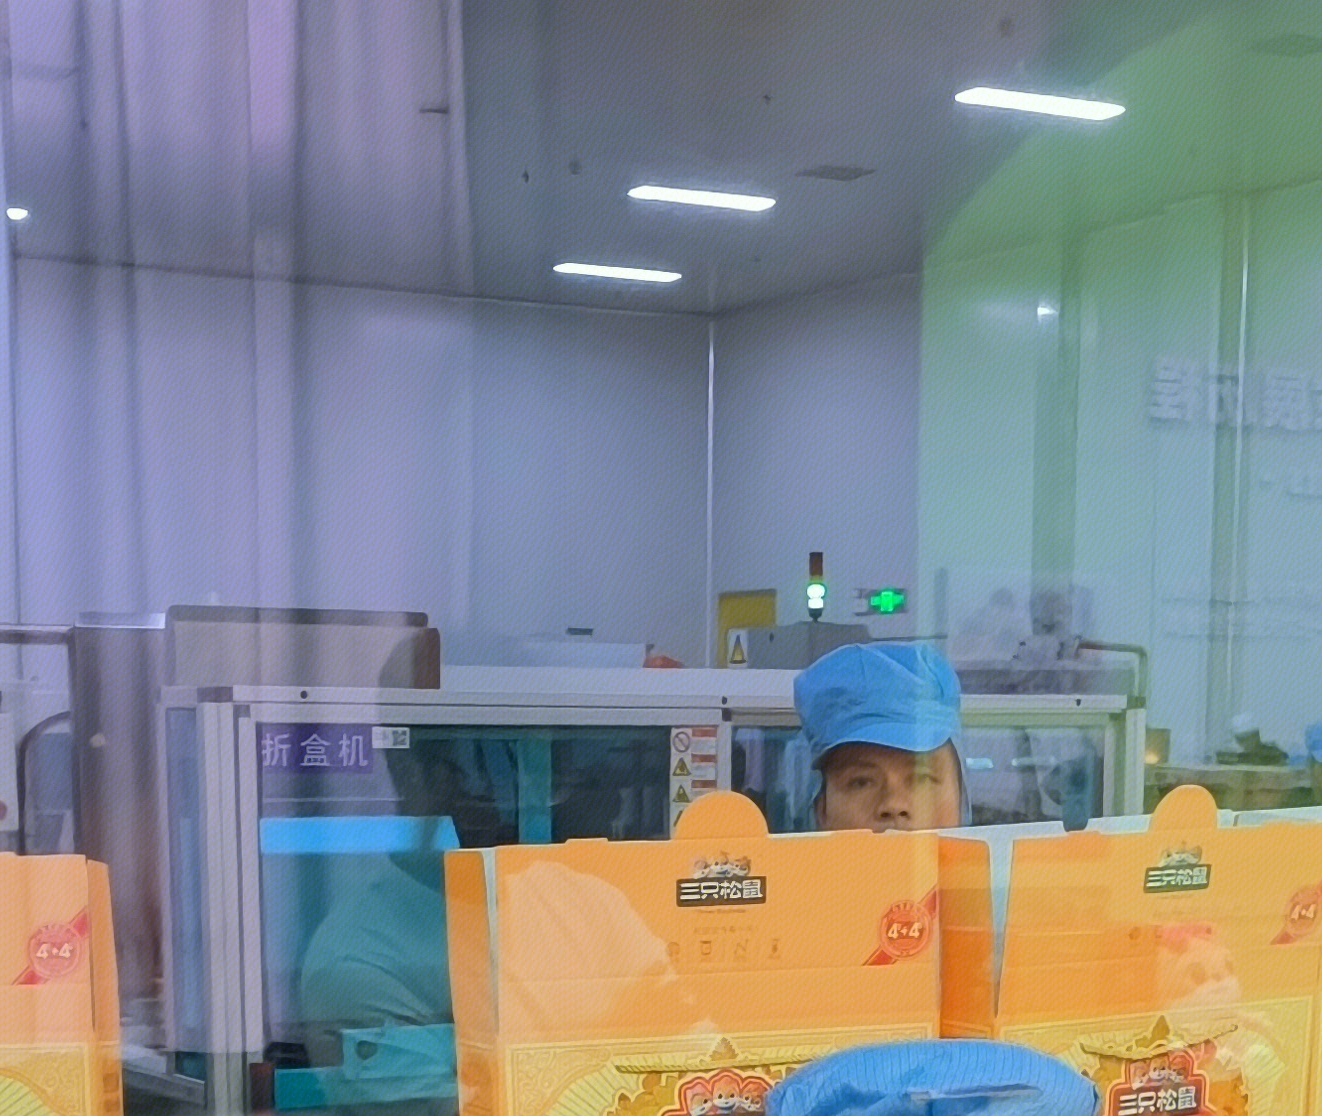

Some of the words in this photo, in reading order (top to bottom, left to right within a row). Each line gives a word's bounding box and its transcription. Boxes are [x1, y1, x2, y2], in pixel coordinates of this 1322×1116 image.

[261, 732, 369, 768] 折盒机
[679, 878, 764, 900] 三只松鼠
[1117, 1085, 1197, 1116] 三只松鼠
